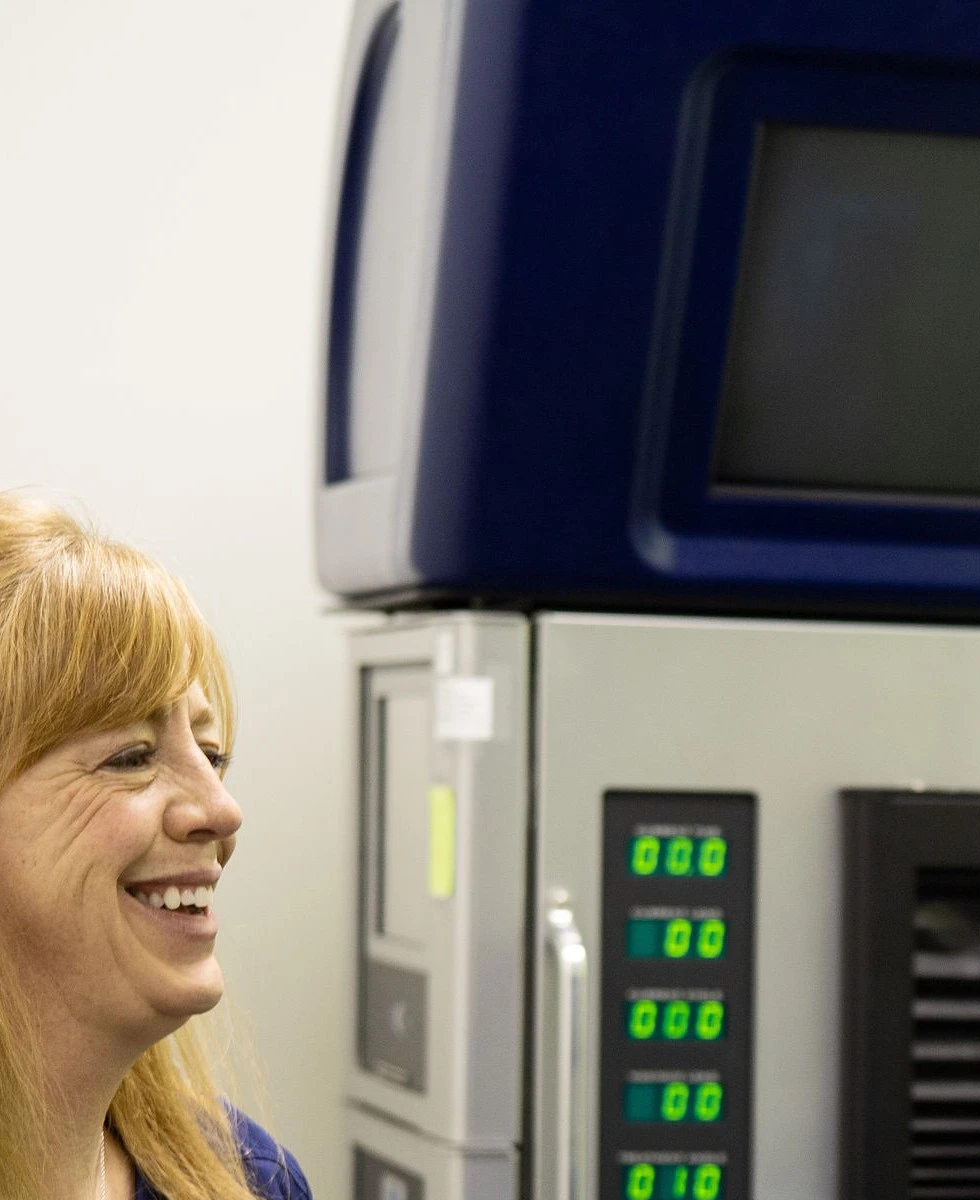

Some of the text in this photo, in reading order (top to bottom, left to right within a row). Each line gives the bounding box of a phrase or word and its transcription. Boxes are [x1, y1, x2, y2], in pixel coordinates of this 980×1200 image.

[631, 834, 727, 877] 000
[664, 918, 726, 958] 00
[629, 999, 724, 1040] 000
[661, 1081, 723, 1121] 00
